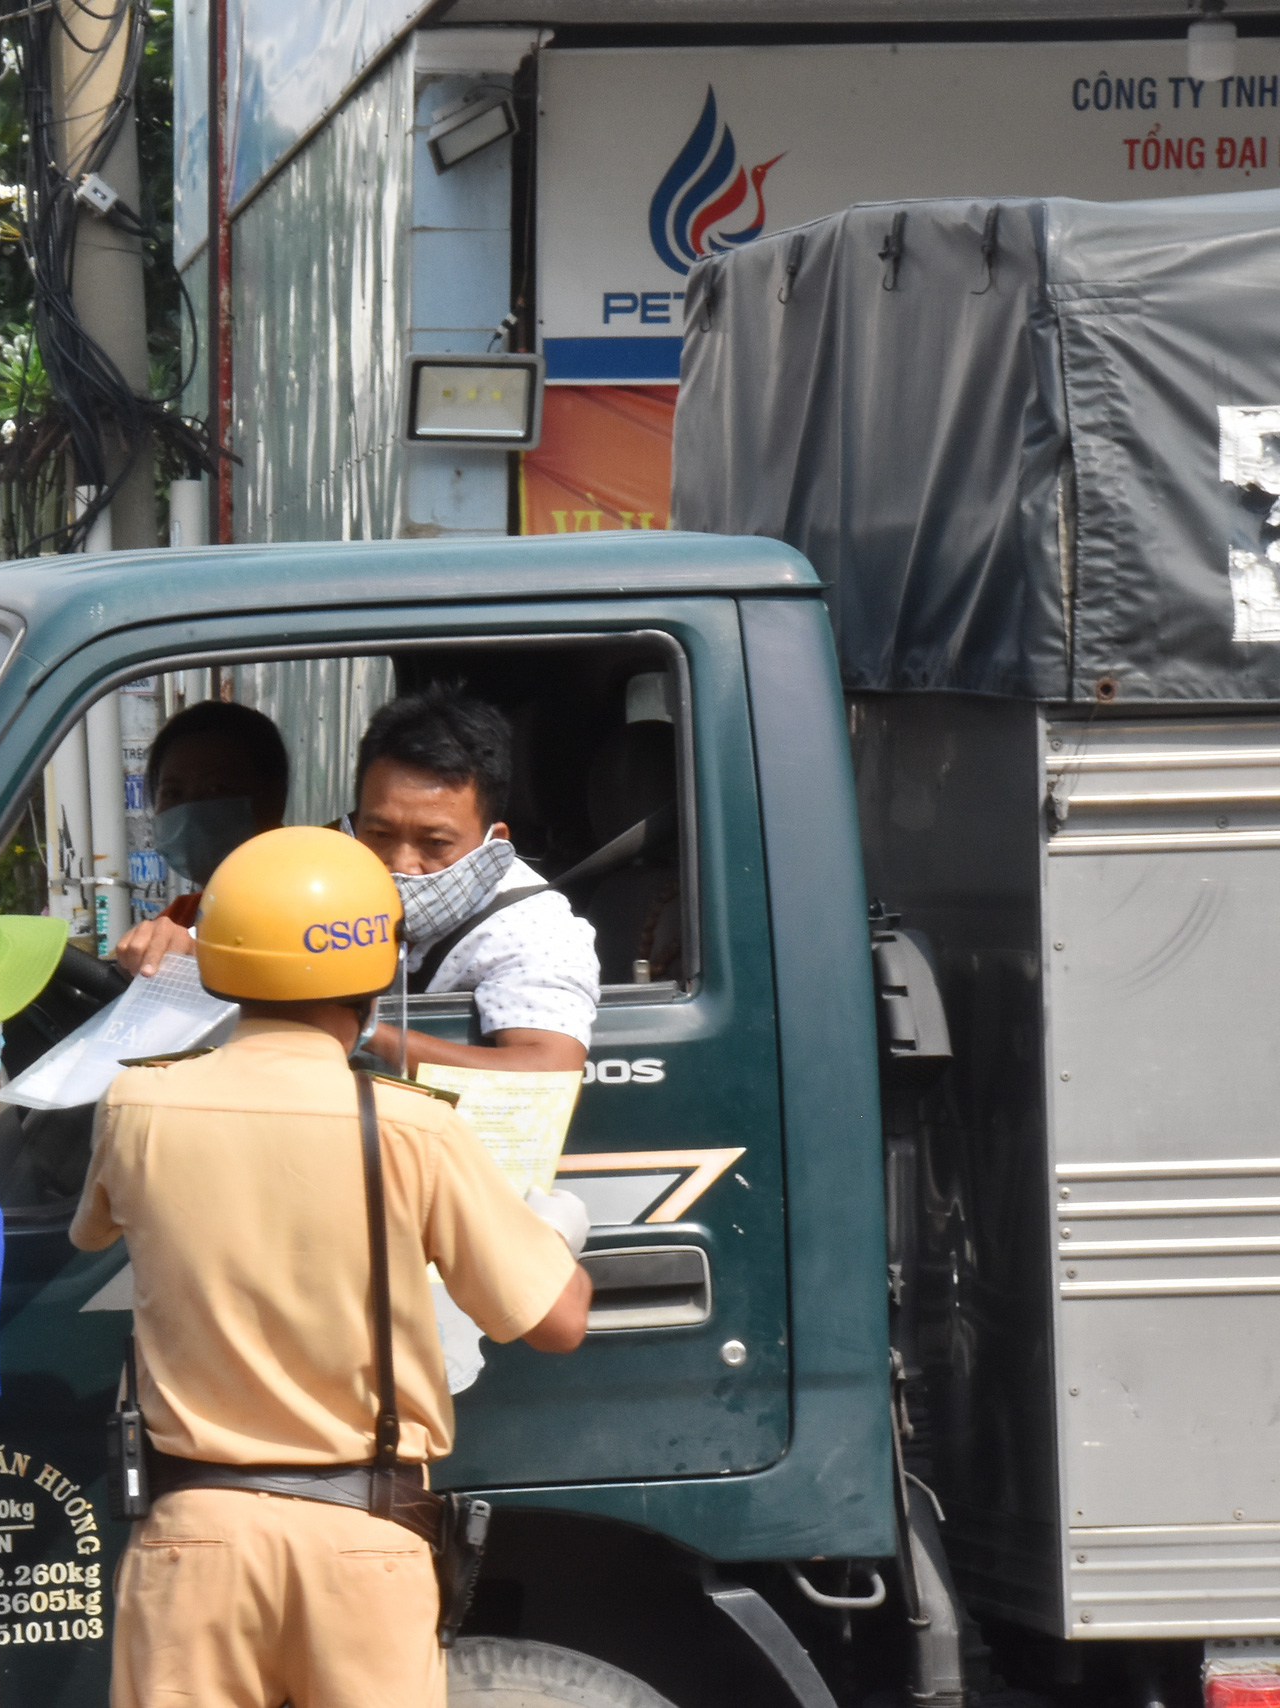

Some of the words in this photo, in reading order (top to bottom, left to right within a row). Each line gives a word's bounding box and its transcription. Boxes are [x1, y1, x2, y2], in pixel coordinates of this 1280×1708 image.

[1073, 69, 1157, 111] CÔNG
[1169, 76, 1204, 108] TY
[1219, 75, 1278, 107] TNH
[1123, 122, 1205, 170] TỔNG
[1216, 136, 1266, 176] ĐẠI
[303, 913, 389, 953] CSGT
[33, 1463, 101, 1555] HƯƠNG
